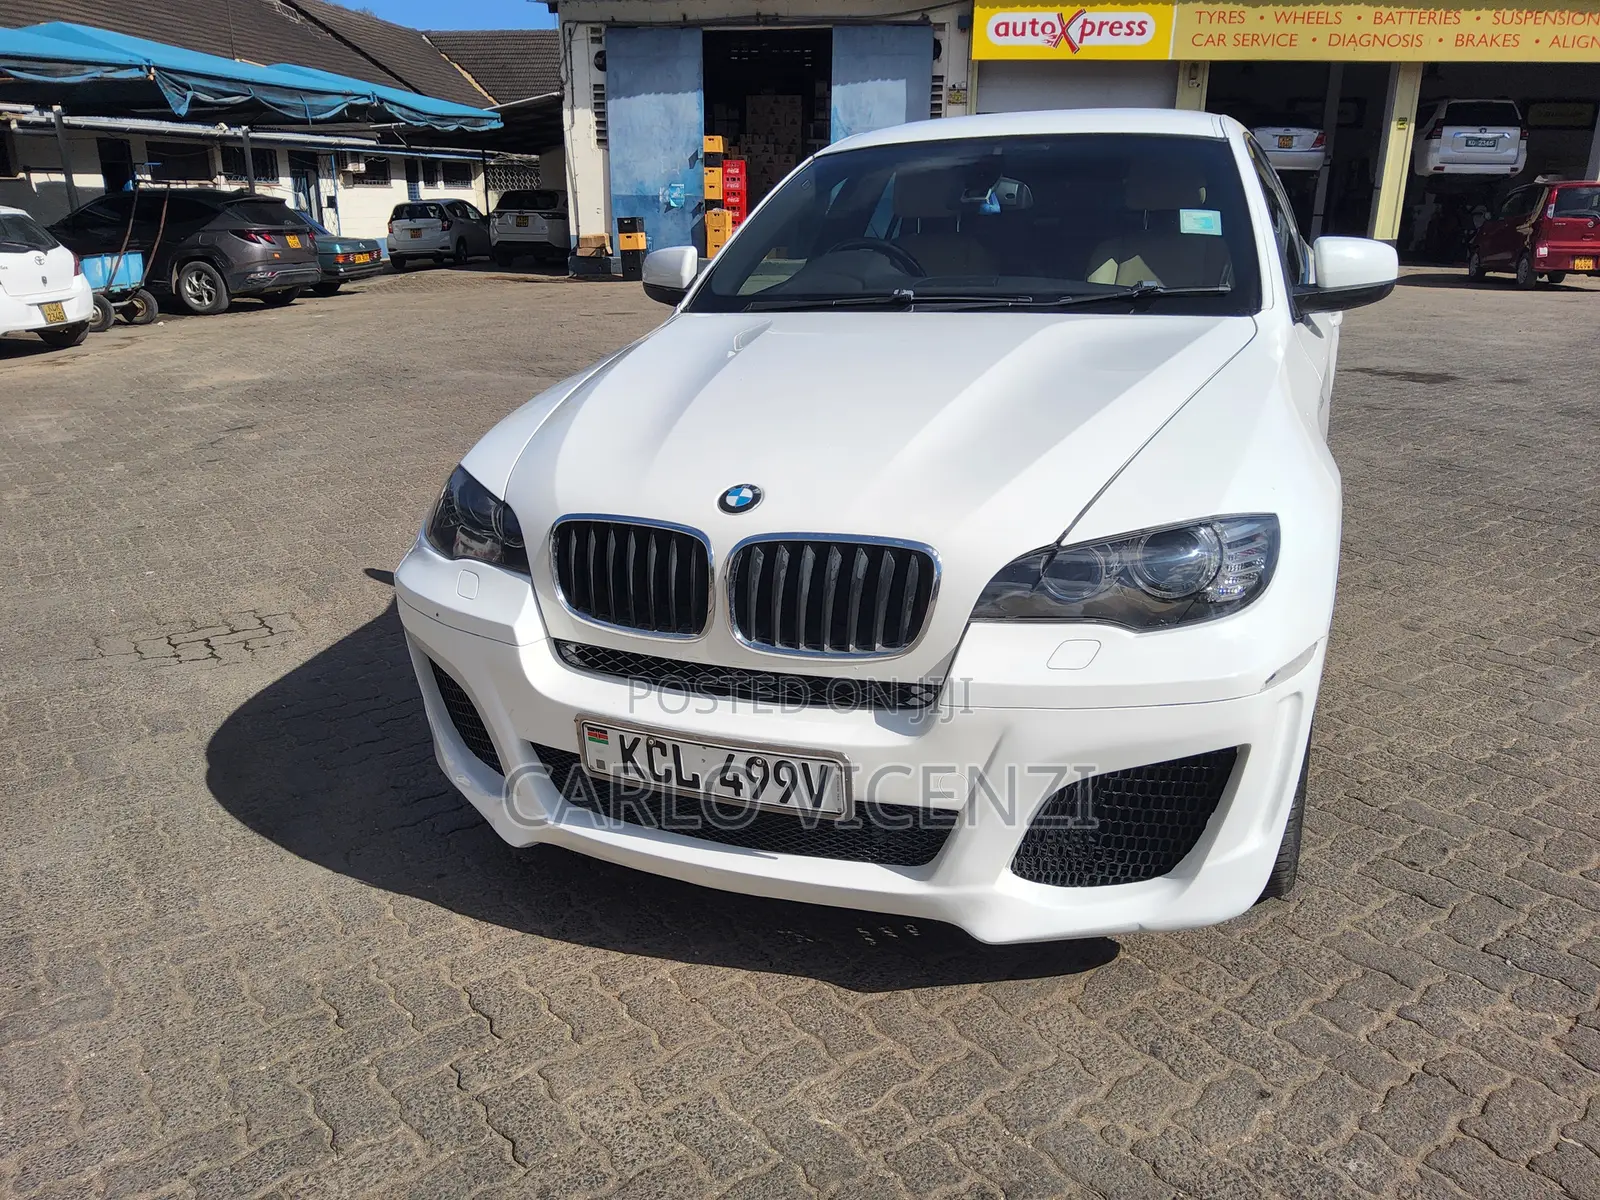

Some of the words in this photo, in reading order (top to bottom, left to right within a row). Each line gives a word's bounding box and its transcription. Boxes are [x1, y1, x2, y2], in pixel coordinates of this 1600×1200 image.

[994, 8, 1148, 54] autoXpress
[1195, 11, 1246, 24] TYRES
[1274, 11, 1343, 25] WHEELS
[1373, 11, 1461, 25] BATTERIES
[1492, 10, 1600, 26] SUSPENSION
[1191, 33, 1227, 47] CAR
[1232, 33, 1299, 47] SERVICE
[1328, 33, 1423, 48] DIAGNOSIS
[1454, 33, 1521, 48] BRAKES
[618, 734, 701, 790] KCL
[719, 753, 830, 809] 499V
